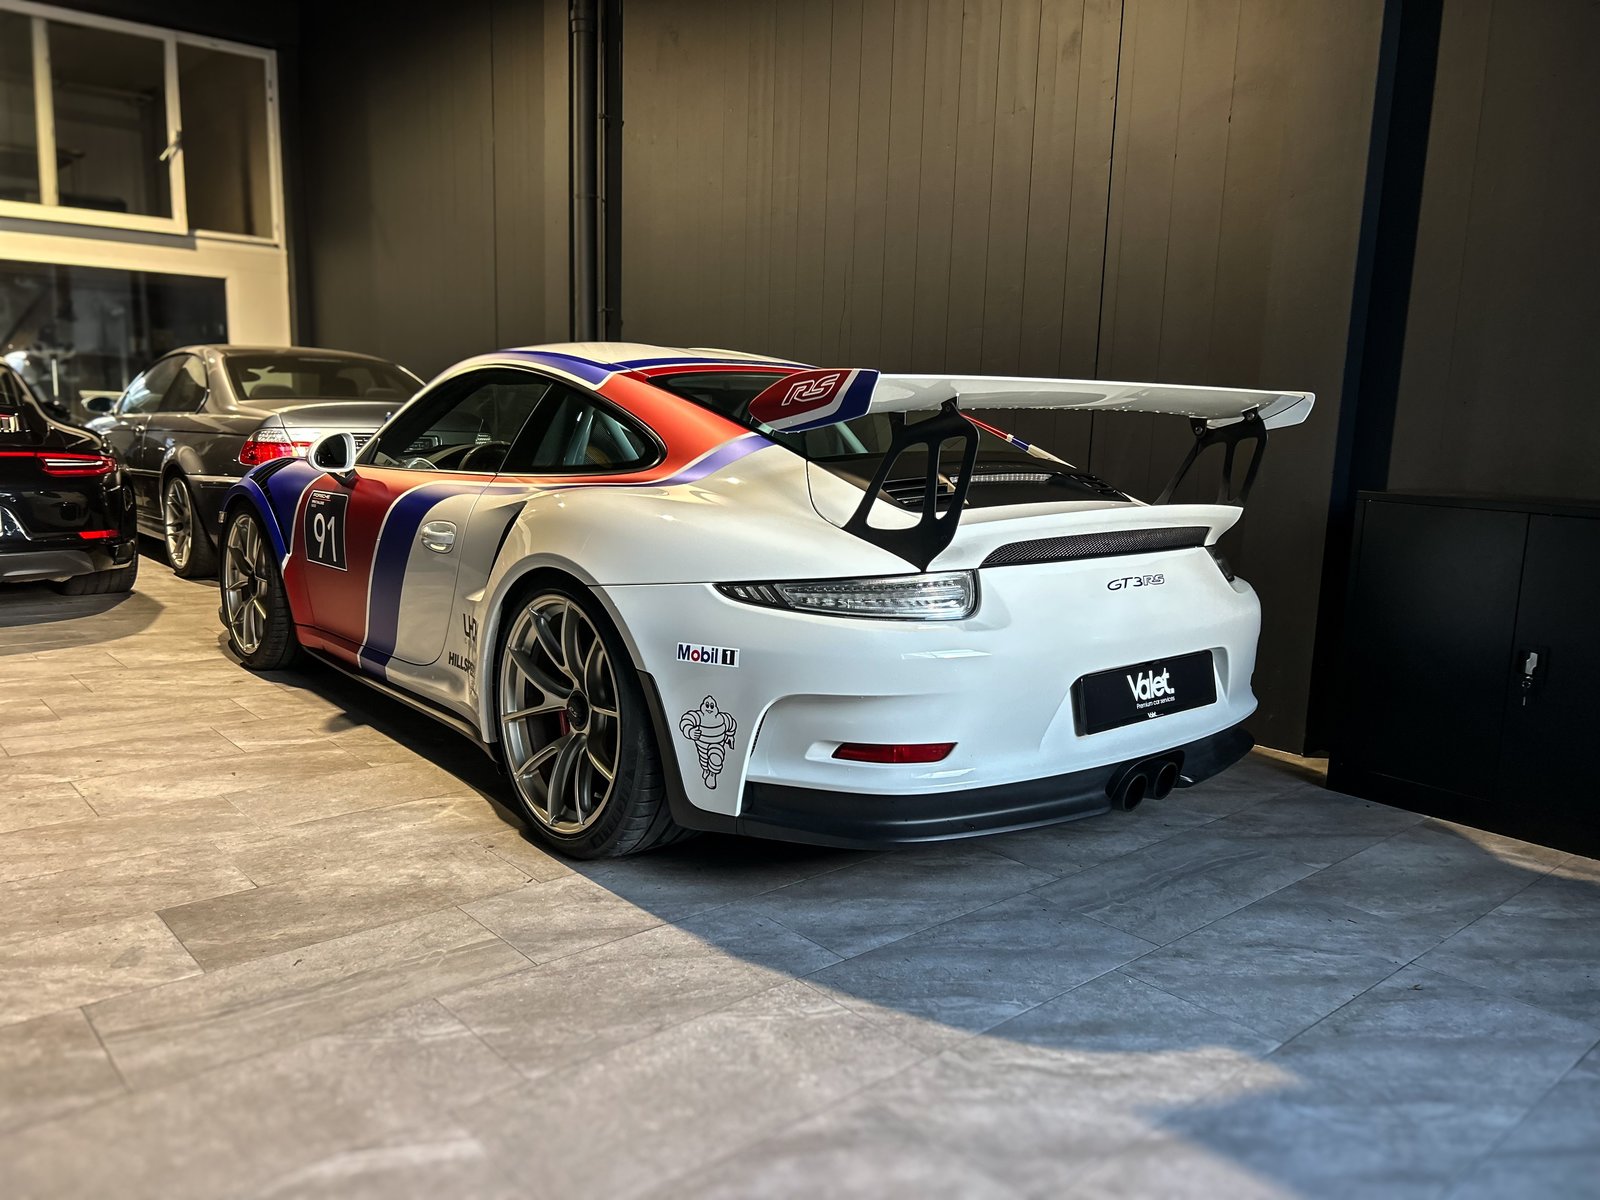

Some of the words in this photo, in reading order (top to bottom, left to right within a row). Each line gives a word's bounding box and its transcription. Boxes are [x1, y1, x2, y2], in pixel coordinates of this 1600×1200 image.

[781, 373, 840, 406] RS
[313, 513, 337, 562] 91
[677, 644, 719, 664] Mobil
[1136, 700, 1154, 710] Premium
